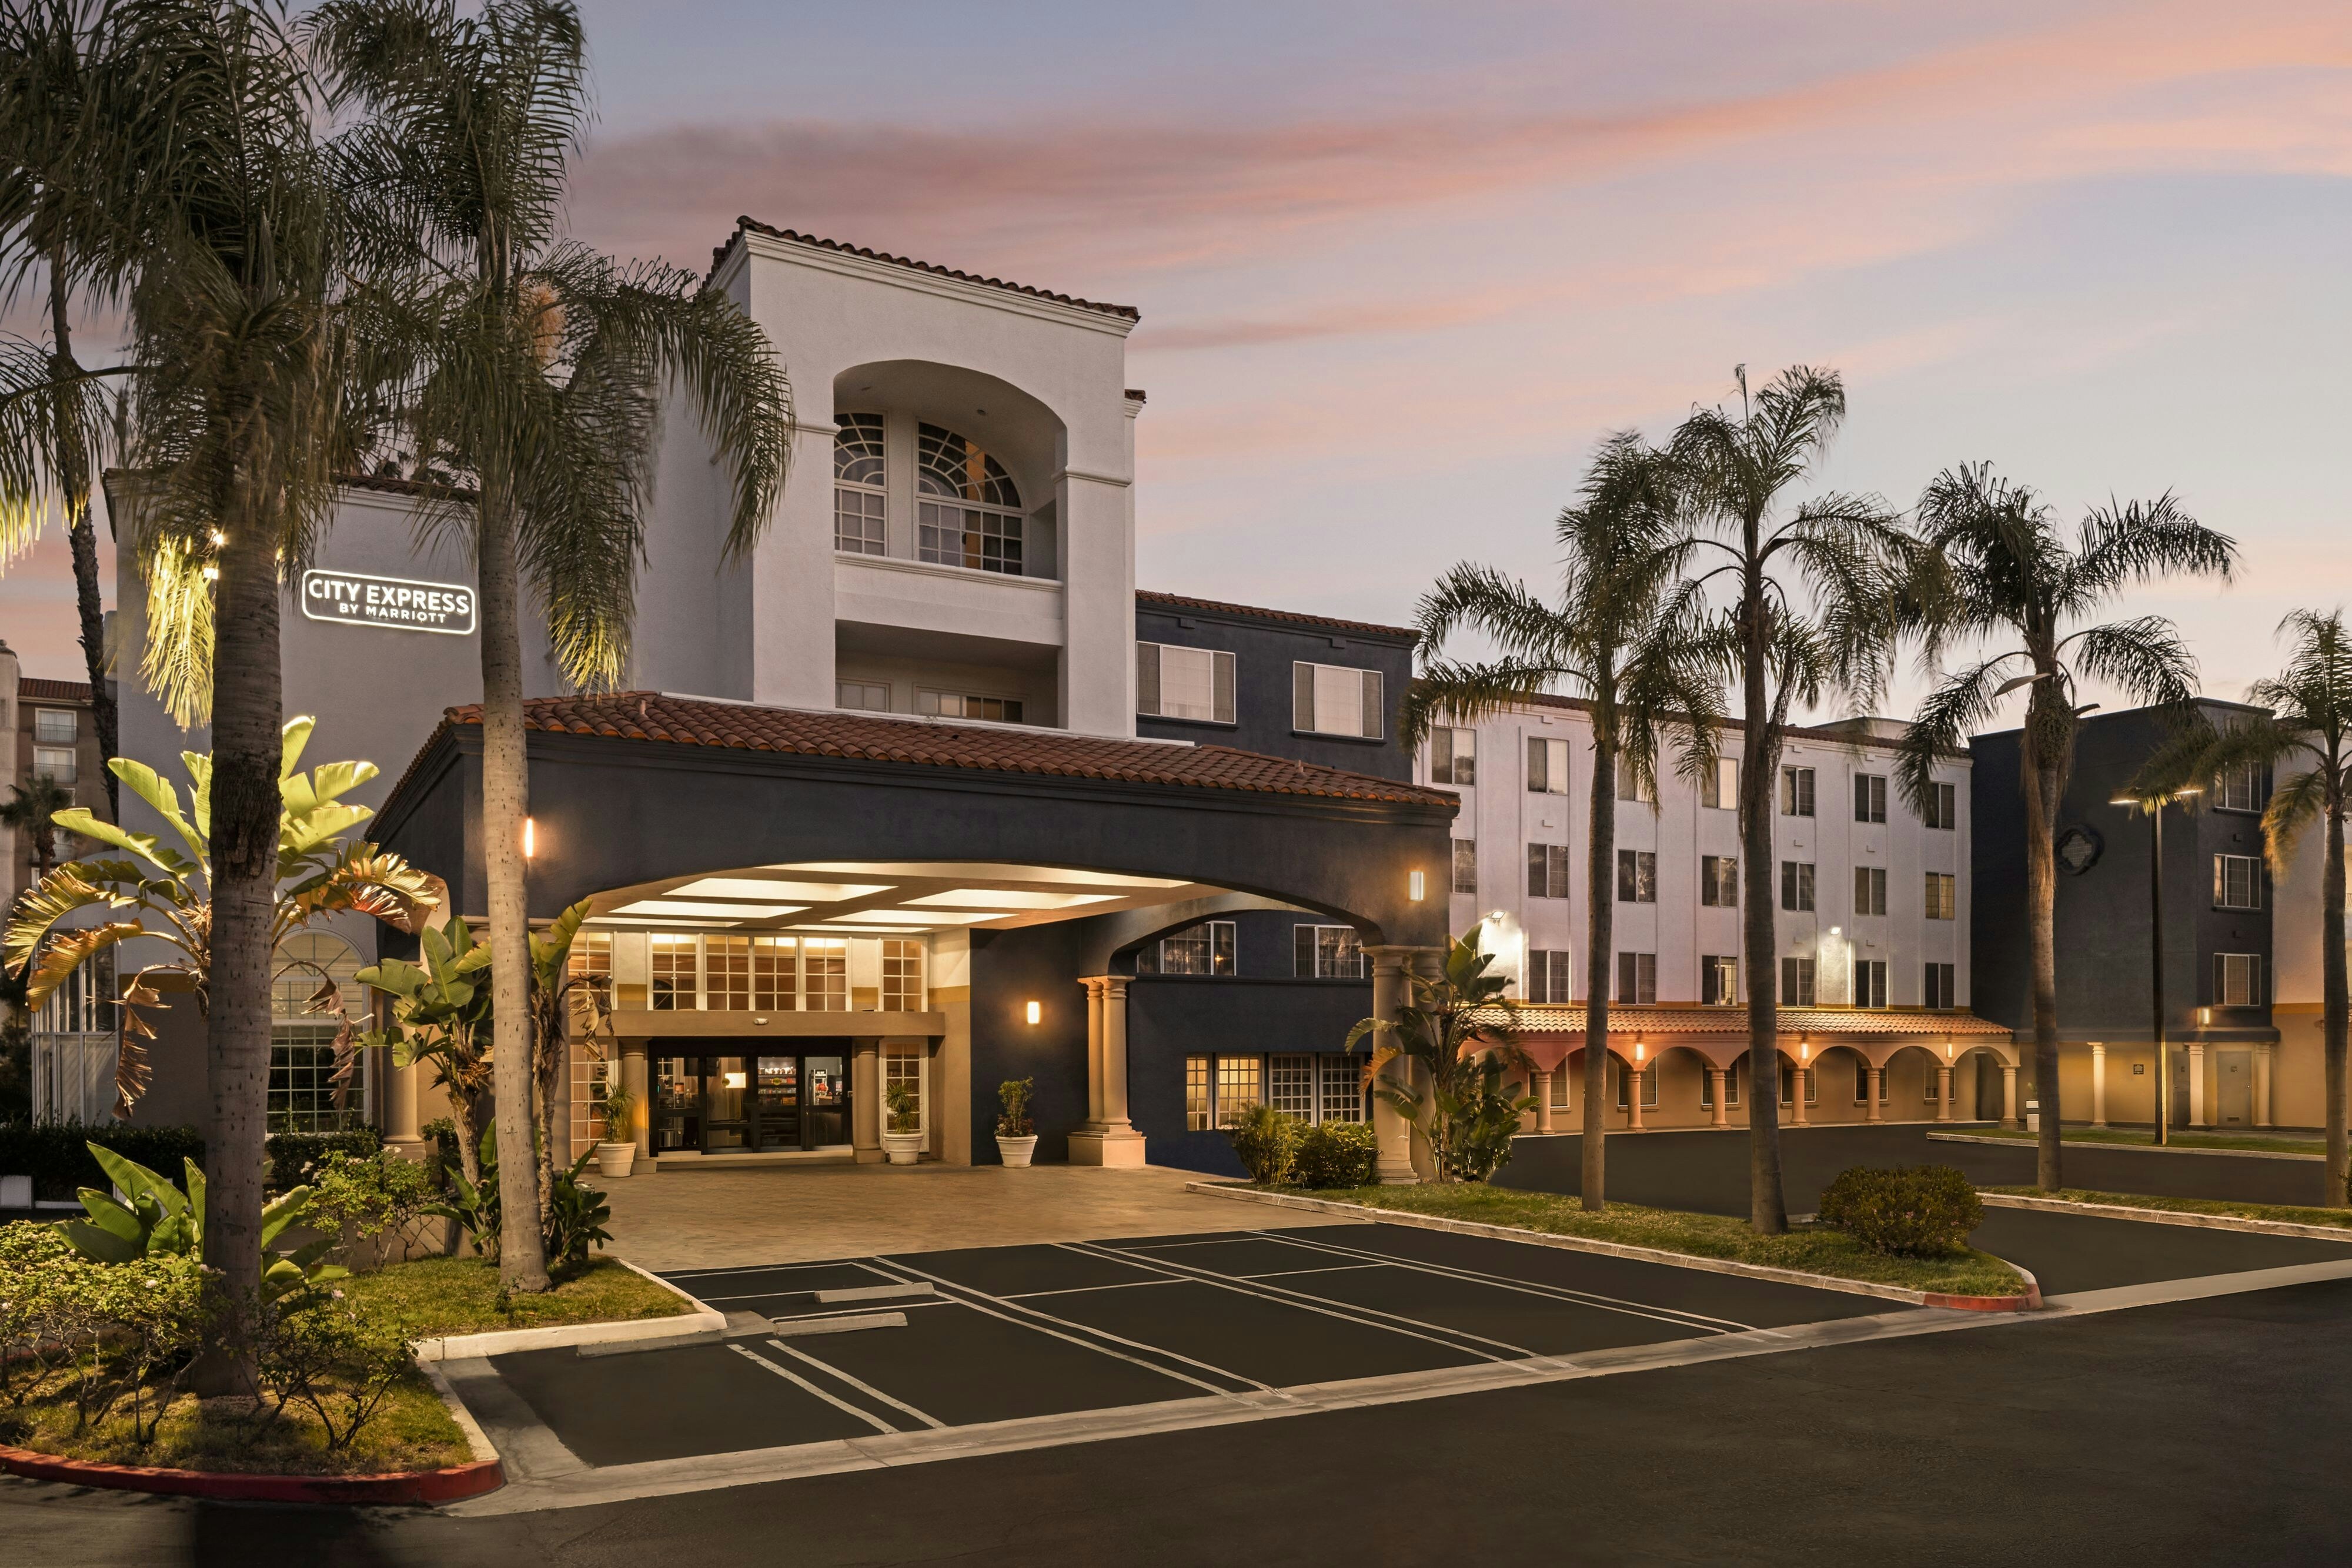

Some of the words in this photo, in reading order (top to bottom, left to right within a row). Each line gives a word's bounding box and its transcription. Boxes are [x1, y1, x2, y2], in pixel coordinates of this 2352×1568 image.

[309, 579, 360, 601] CITY
[366, 585, 469, 614] EXPRESS
[339, 603, 359, 614] BY
[366, 606, 446, 623] MARRIOTT
